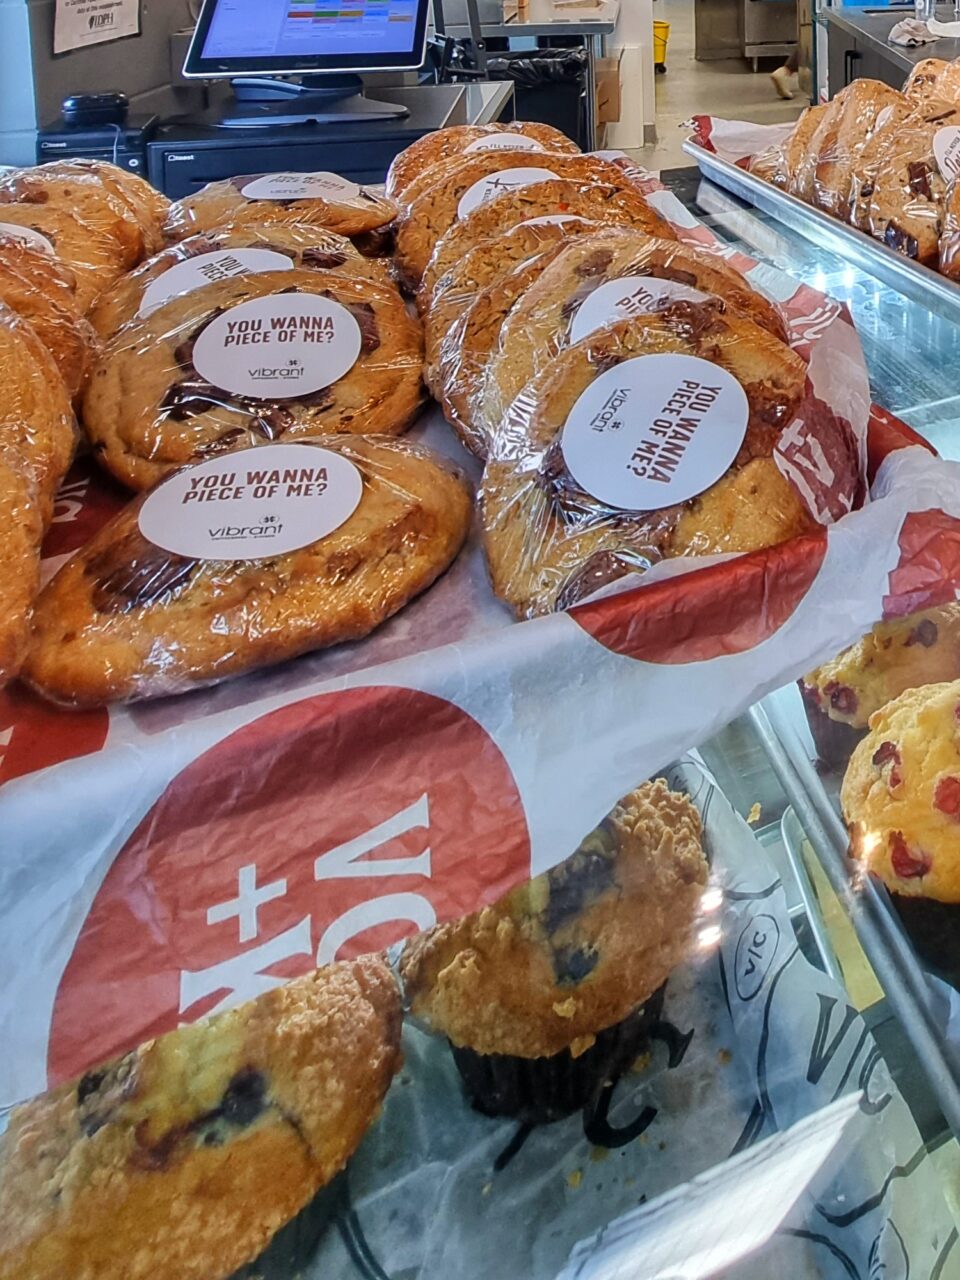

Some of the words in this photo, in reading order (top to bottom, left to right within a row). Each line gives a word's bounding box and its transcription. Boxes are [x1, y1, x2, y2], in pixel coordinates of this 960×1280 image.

[215, 255, 243, 271] YOU
[227, 319, 262, 334] YOU
[270, 316, 334, 331] WANNA
[224, 331, 271, 348] PIECE
[278, 330, 297, 342] OF
[303, 331, 335, 344] ME?
[248, 367, 304, 377] vibrant
[661, 379, 700, 414] PIECE
[688, 386, 723, 413] YOU
[592, 388, 632, 433] vibrant
[649, 419, 673, 438] OF
[626, 439, 660, 478] ME?
[647, 418, 702, 484] WANNA
[190, 473, 236, 490] YOU
[246, 468, 328, 485] WANNA
[182, 486, 245, 504] PIECE
[252, 485, 278, 499] OF
[286, 483, 328, 498] ME?
[208, 524, 283, 537] vibrant
[743, 930, 767, 976] V/C
